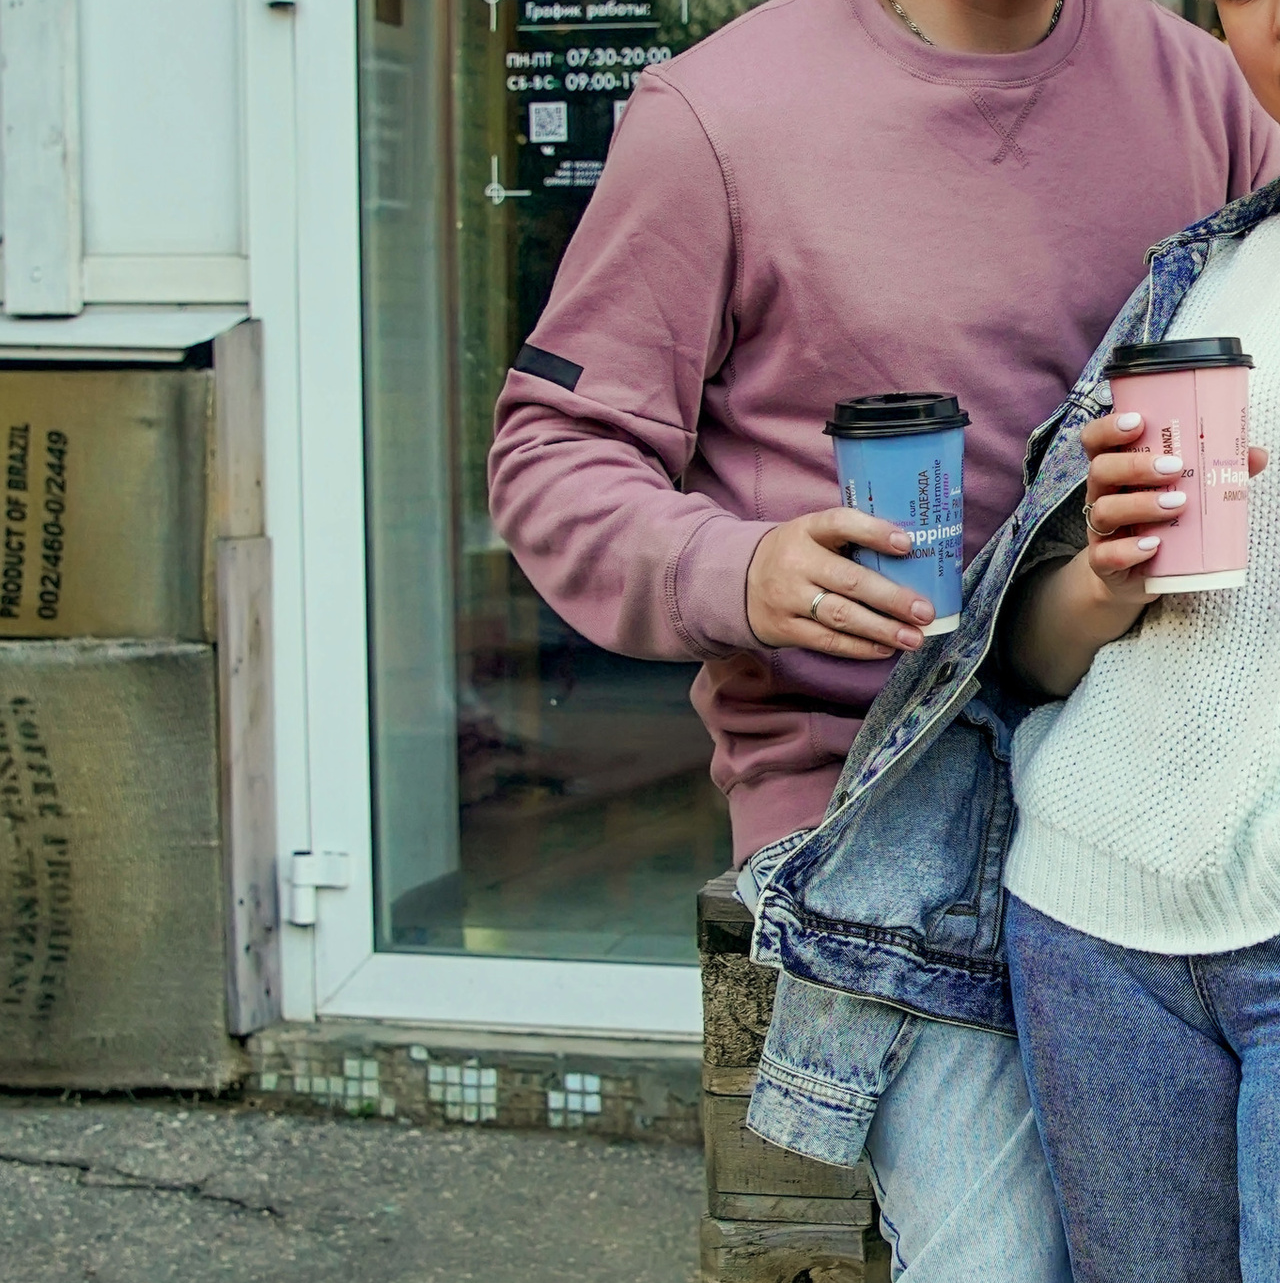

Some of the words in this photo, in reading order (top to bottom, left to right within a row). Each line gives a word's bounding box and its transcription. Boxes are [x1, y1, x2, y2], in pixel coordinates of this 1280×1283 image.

[524, 1, 583, 22] График
[585, 0, 652, 21] работы:
[566, 47, 672, 69] 07:30-20:00
[6, 423, 30, 492] BRAZIL
[6, 495, 28, 521] OF
[918, 470, 930, 526] НАДЕЖДА
[931, 459, 942, 515] Harmonie
[36, 430, 69, 621] 002/460-0/2449
[906, 522, 963, 546] appiness
[0, 527, 25, 620] PRODUCT
